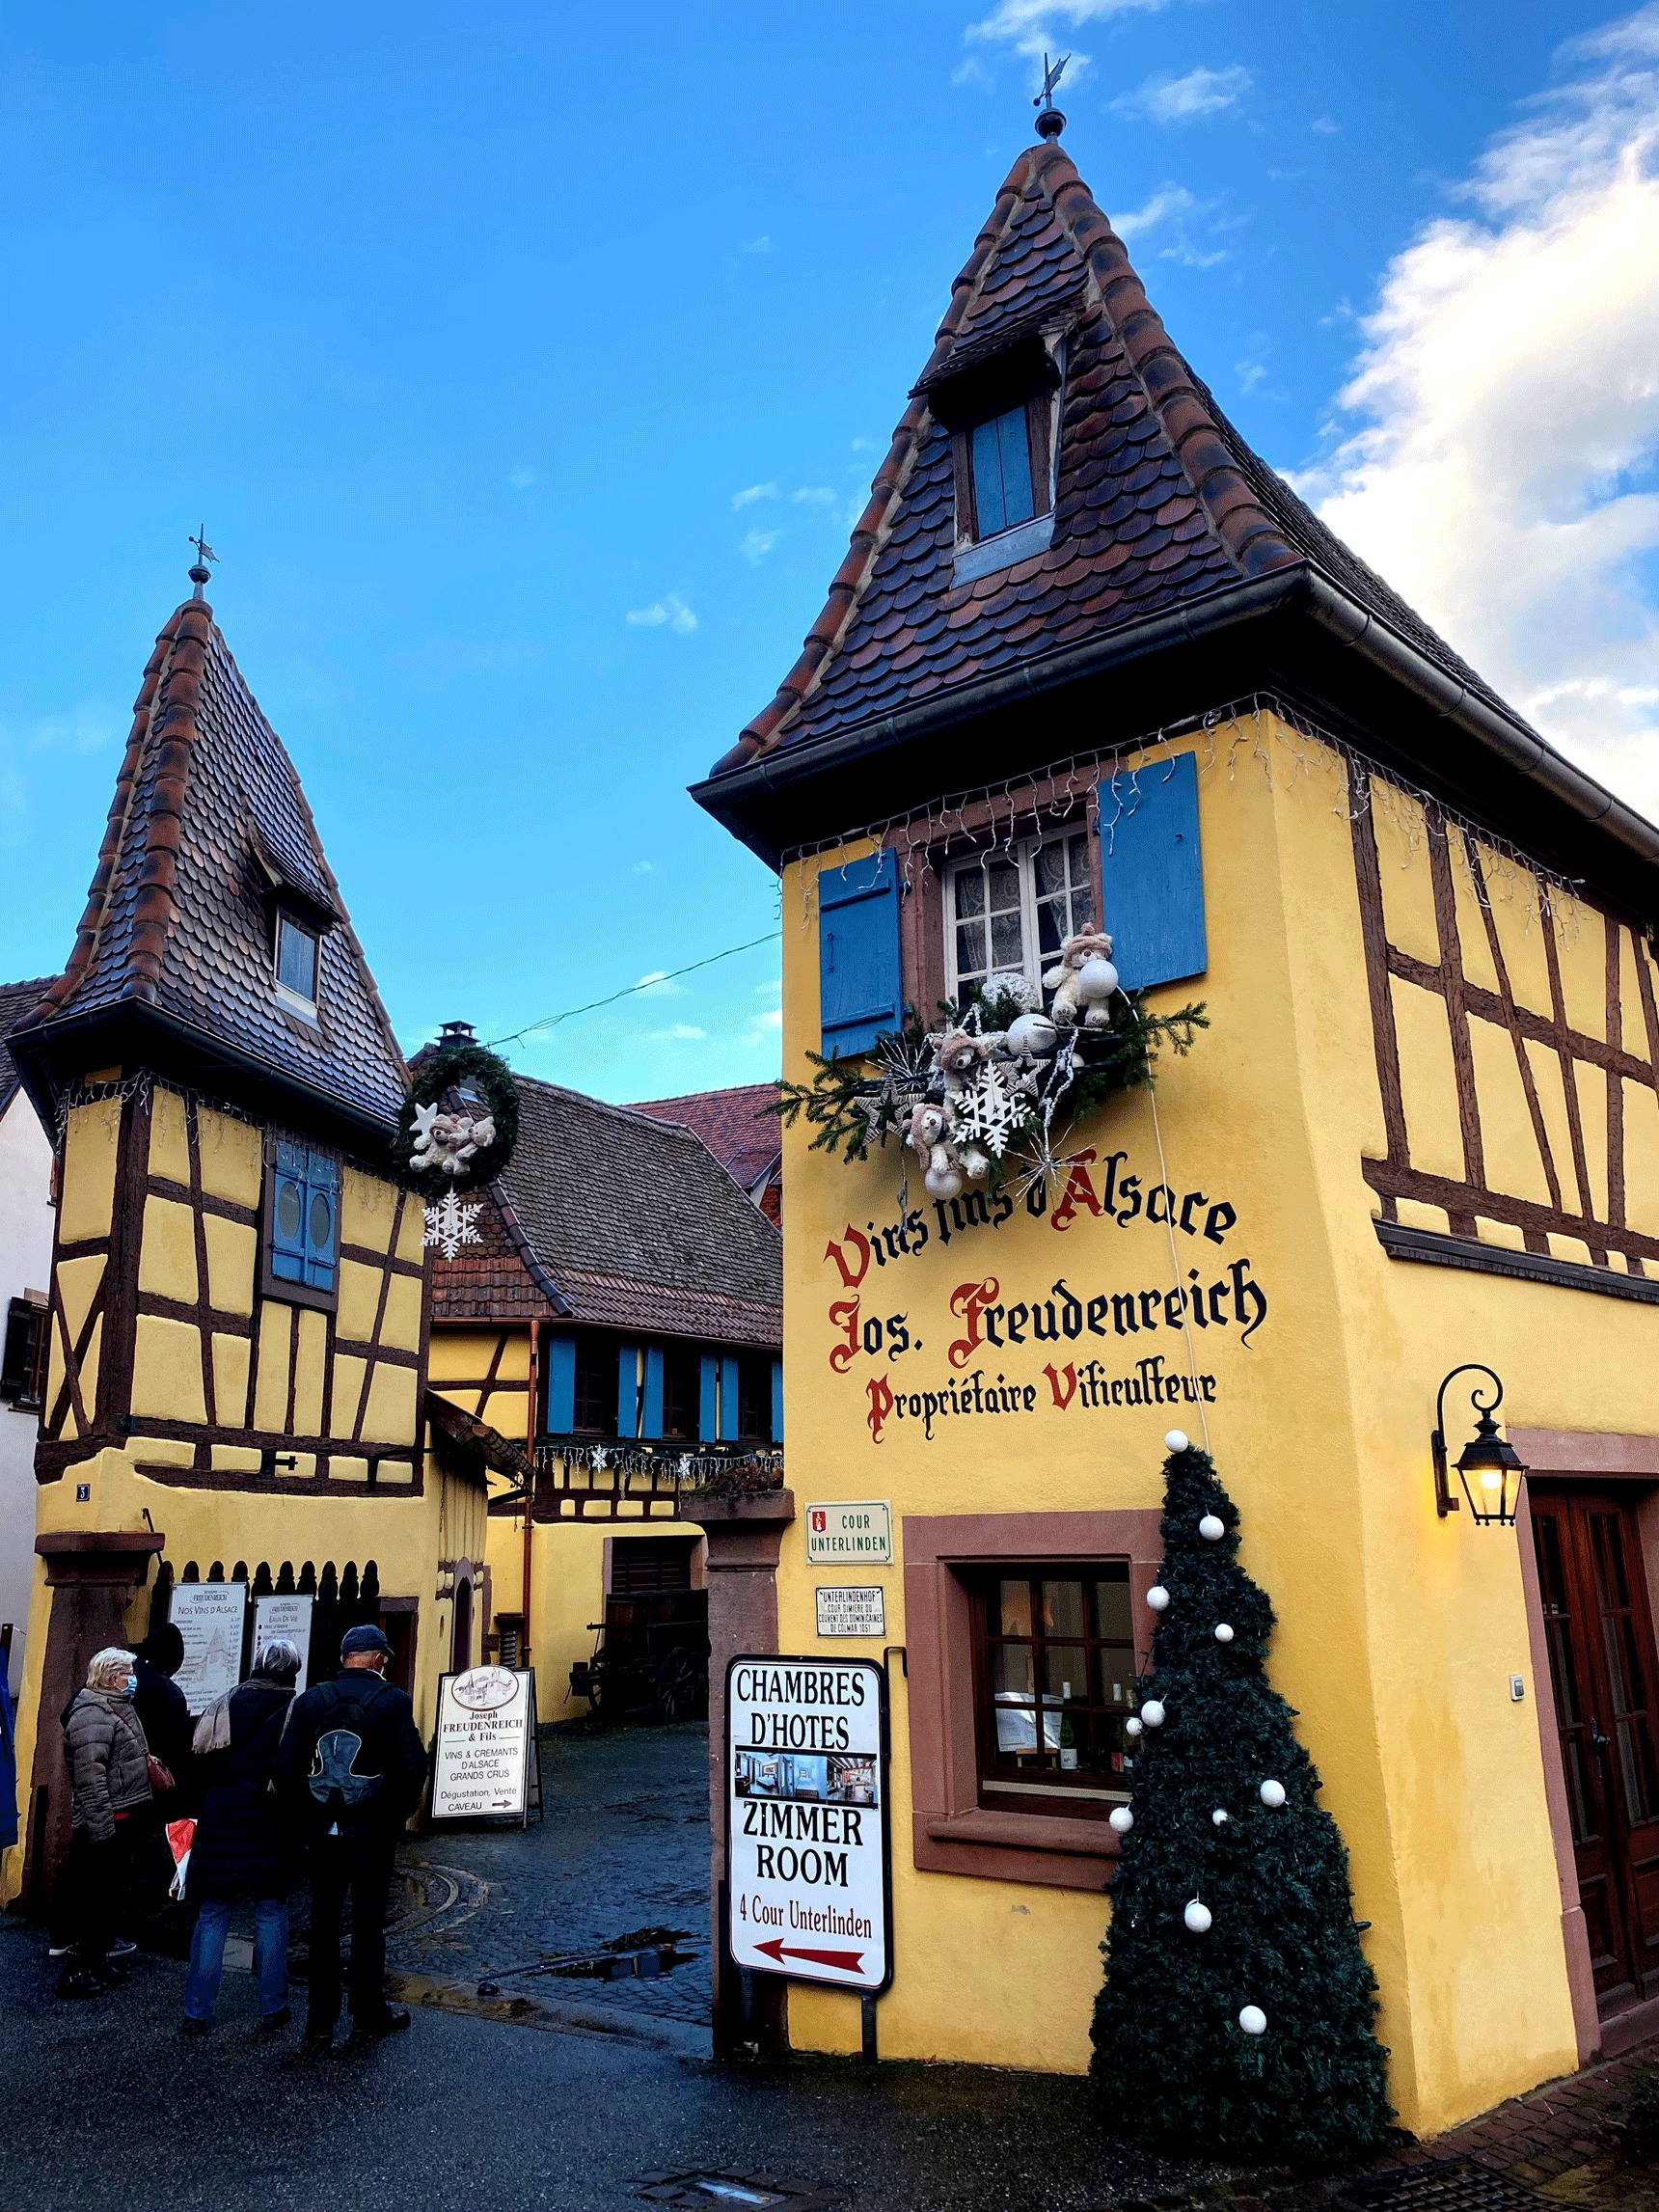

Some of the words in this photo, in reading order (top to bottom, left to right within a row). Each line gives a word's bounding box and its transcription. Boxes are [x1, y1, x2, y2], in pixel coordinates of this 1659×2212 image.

[823, 1208, 929, 1289] Vins
[829, 1294, 923, 1373] Jos.
[948, 1259, 1267, 1369] Freudenreich
[865, 1370, 1037, 1444] Propriétaire
[1042, 1355, 1217, 1412] Viticulteur
[80, 1487, 85, 1498] 3
[842, 1515, 870, 1529] COUR
[811, 1537, 886, 1551] UNTERLINDEN
[823, 1590, 876, 1603] UNTERLINDENHOF
[837, 1624, 858, 1633] COLMAR
[736, 1668, 865, 1707] CHAMBRES
[469, 1710, 498, 1721] Joseph
[444, 1719, 524, 1733] FREUDENREICH
[750, 1712, 850, 1751] D'HOTES
[468, 1733, 476, 1742] &
[479, 1732, 497, 1741] Fils
[445, 1750, 463, 1760] VINS
[466, 1750, 471, 1759] &
[474, 1747, 519, 1758] CREMANTS
[449, 1770, 484, 1782] GRANDS
[486, 1768, 510, 1779] CRUS
[494, 1788, 517, 1796] Vente
[448, 1801, 482, 1812] CAVEAU
[743, 1801, 863, 1846] ZIMMER
[756, 1844, 849, 1888] ROOM
[740, 1893, 748, 1922] 4
[751, 1895, 784, 1927] Cour
[789, 1899, 873, 1939] Unterlinden
